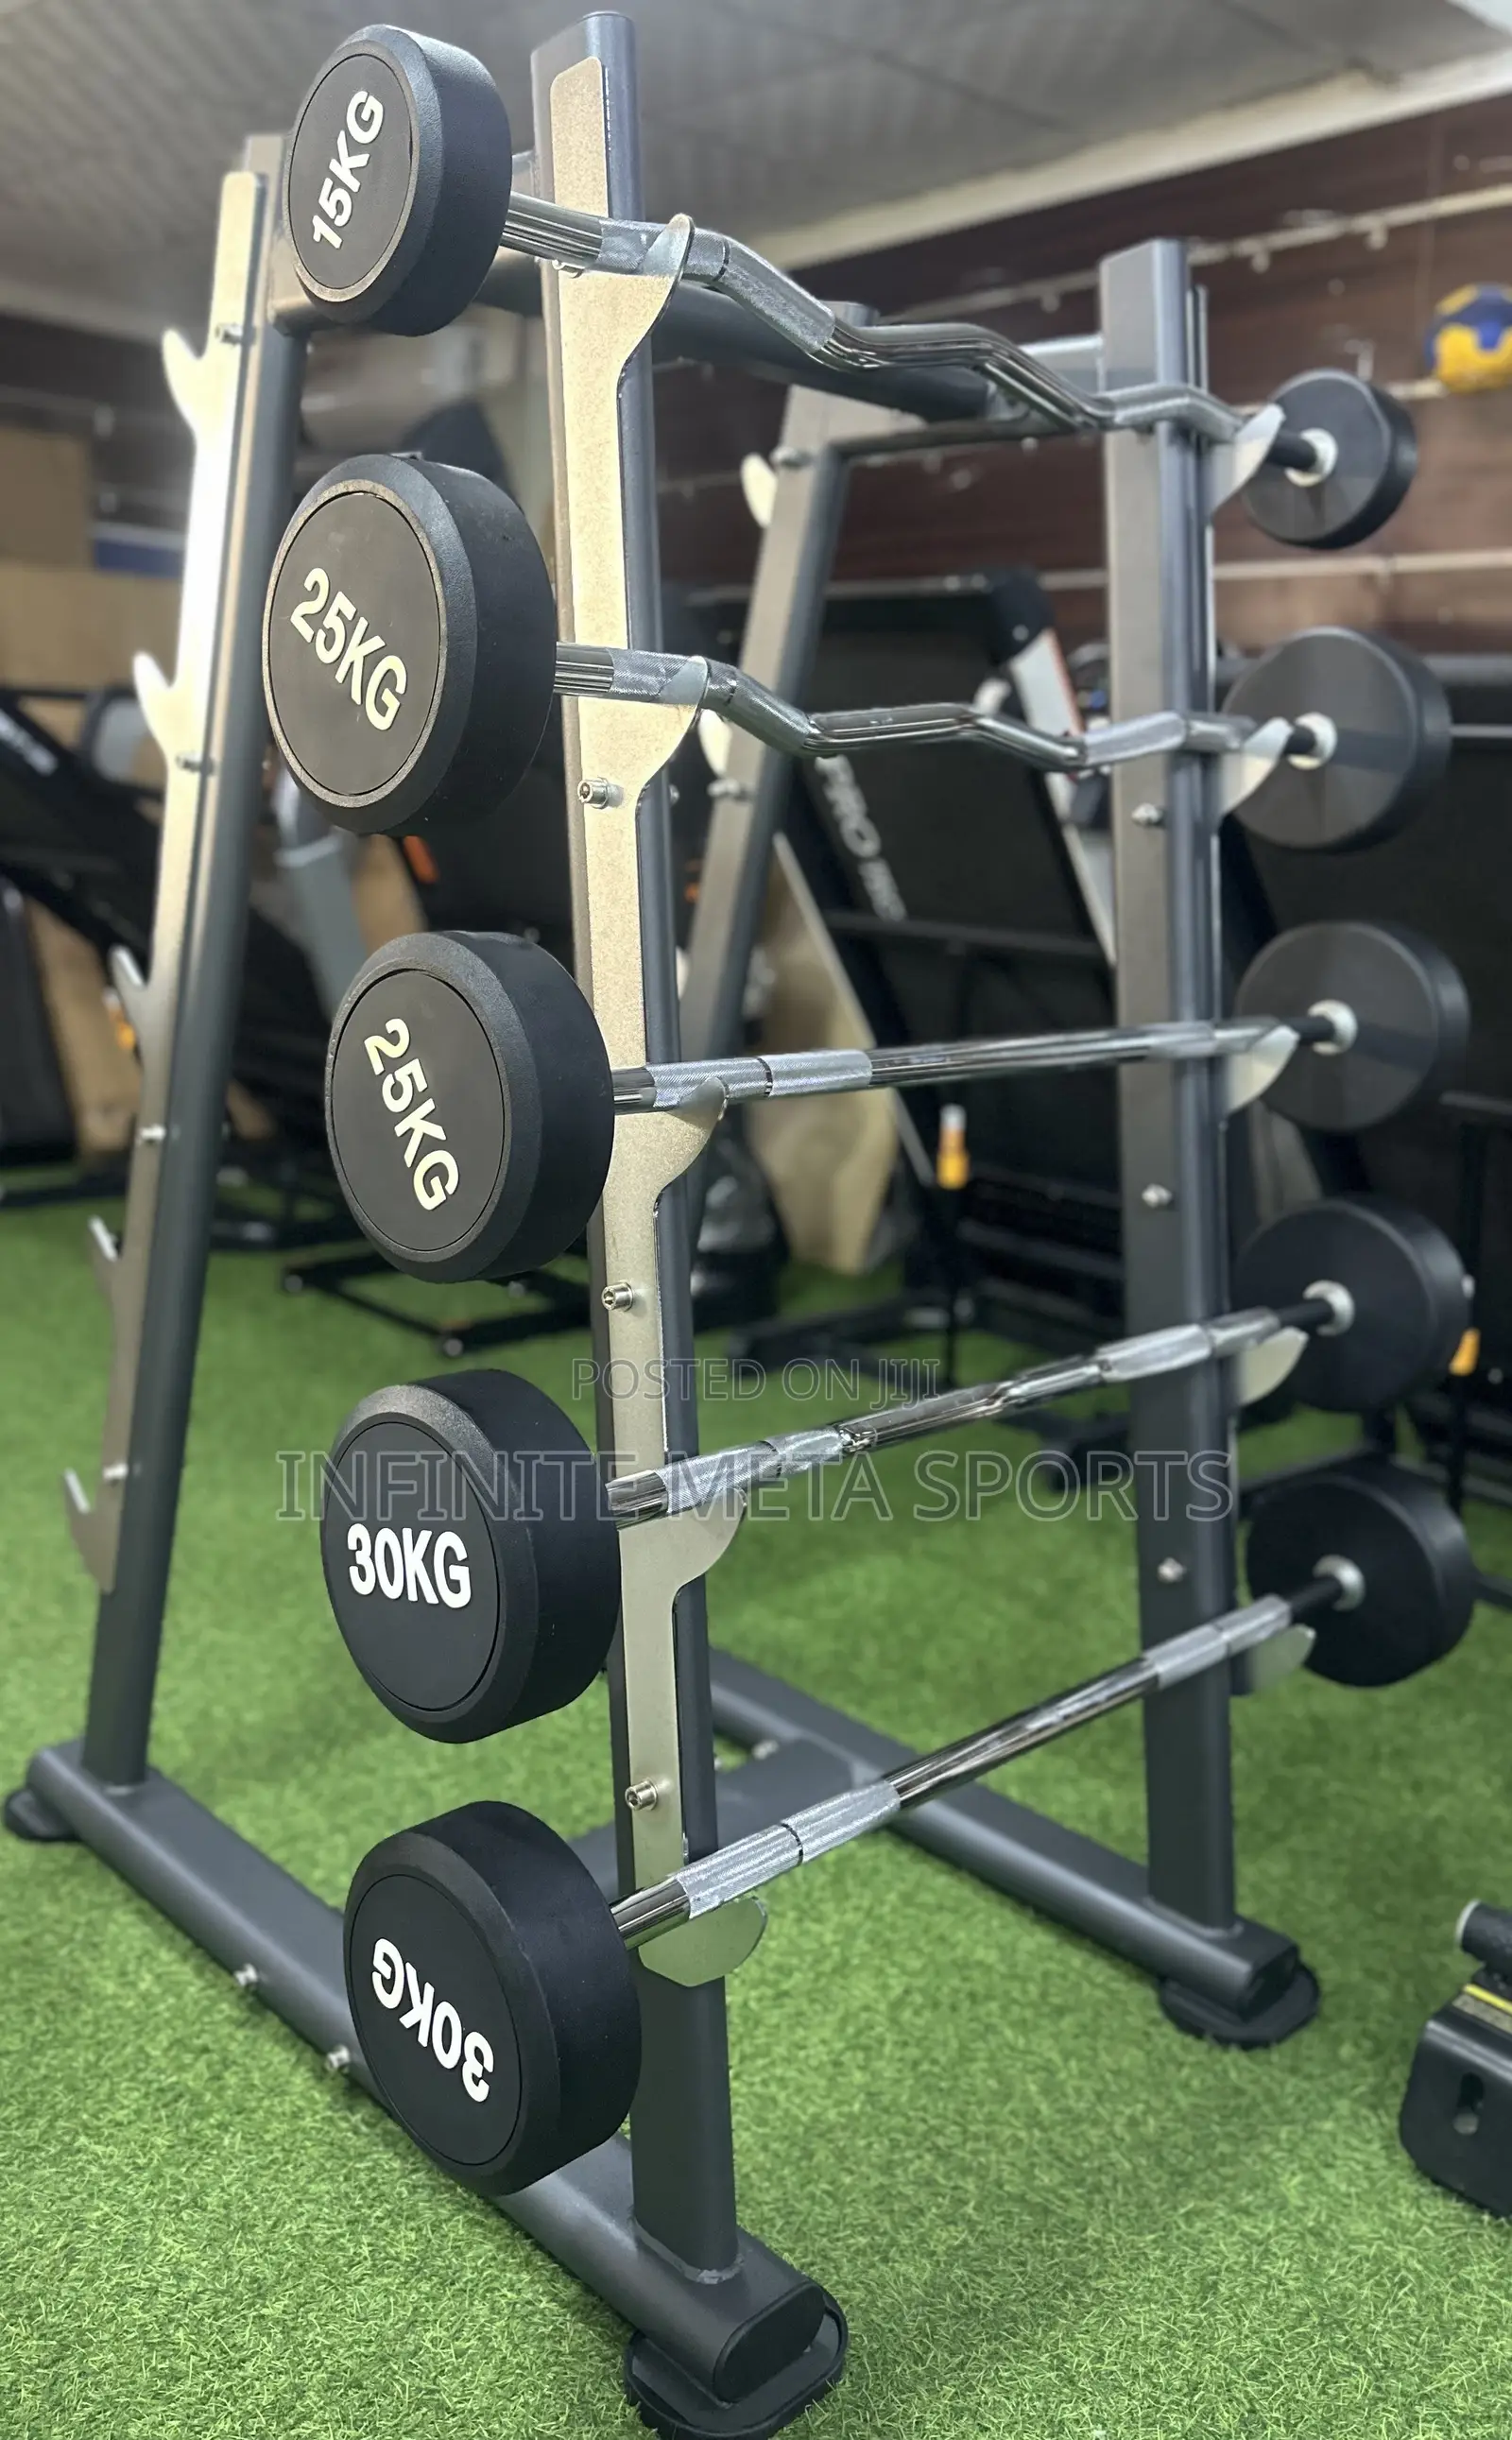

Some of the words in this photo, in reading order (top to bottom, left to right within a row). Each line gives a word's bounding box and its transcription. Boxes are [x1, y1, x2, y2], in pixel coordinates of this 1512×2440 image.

[312, 90, 385, 250] 15KG
[290, 567, 408, 731] 25KG
[364, 1018, 459, 1211] 25KG
[347, 1522, 472, 1608] 30KG
[371, 1938, 494, 2103] 30KG
